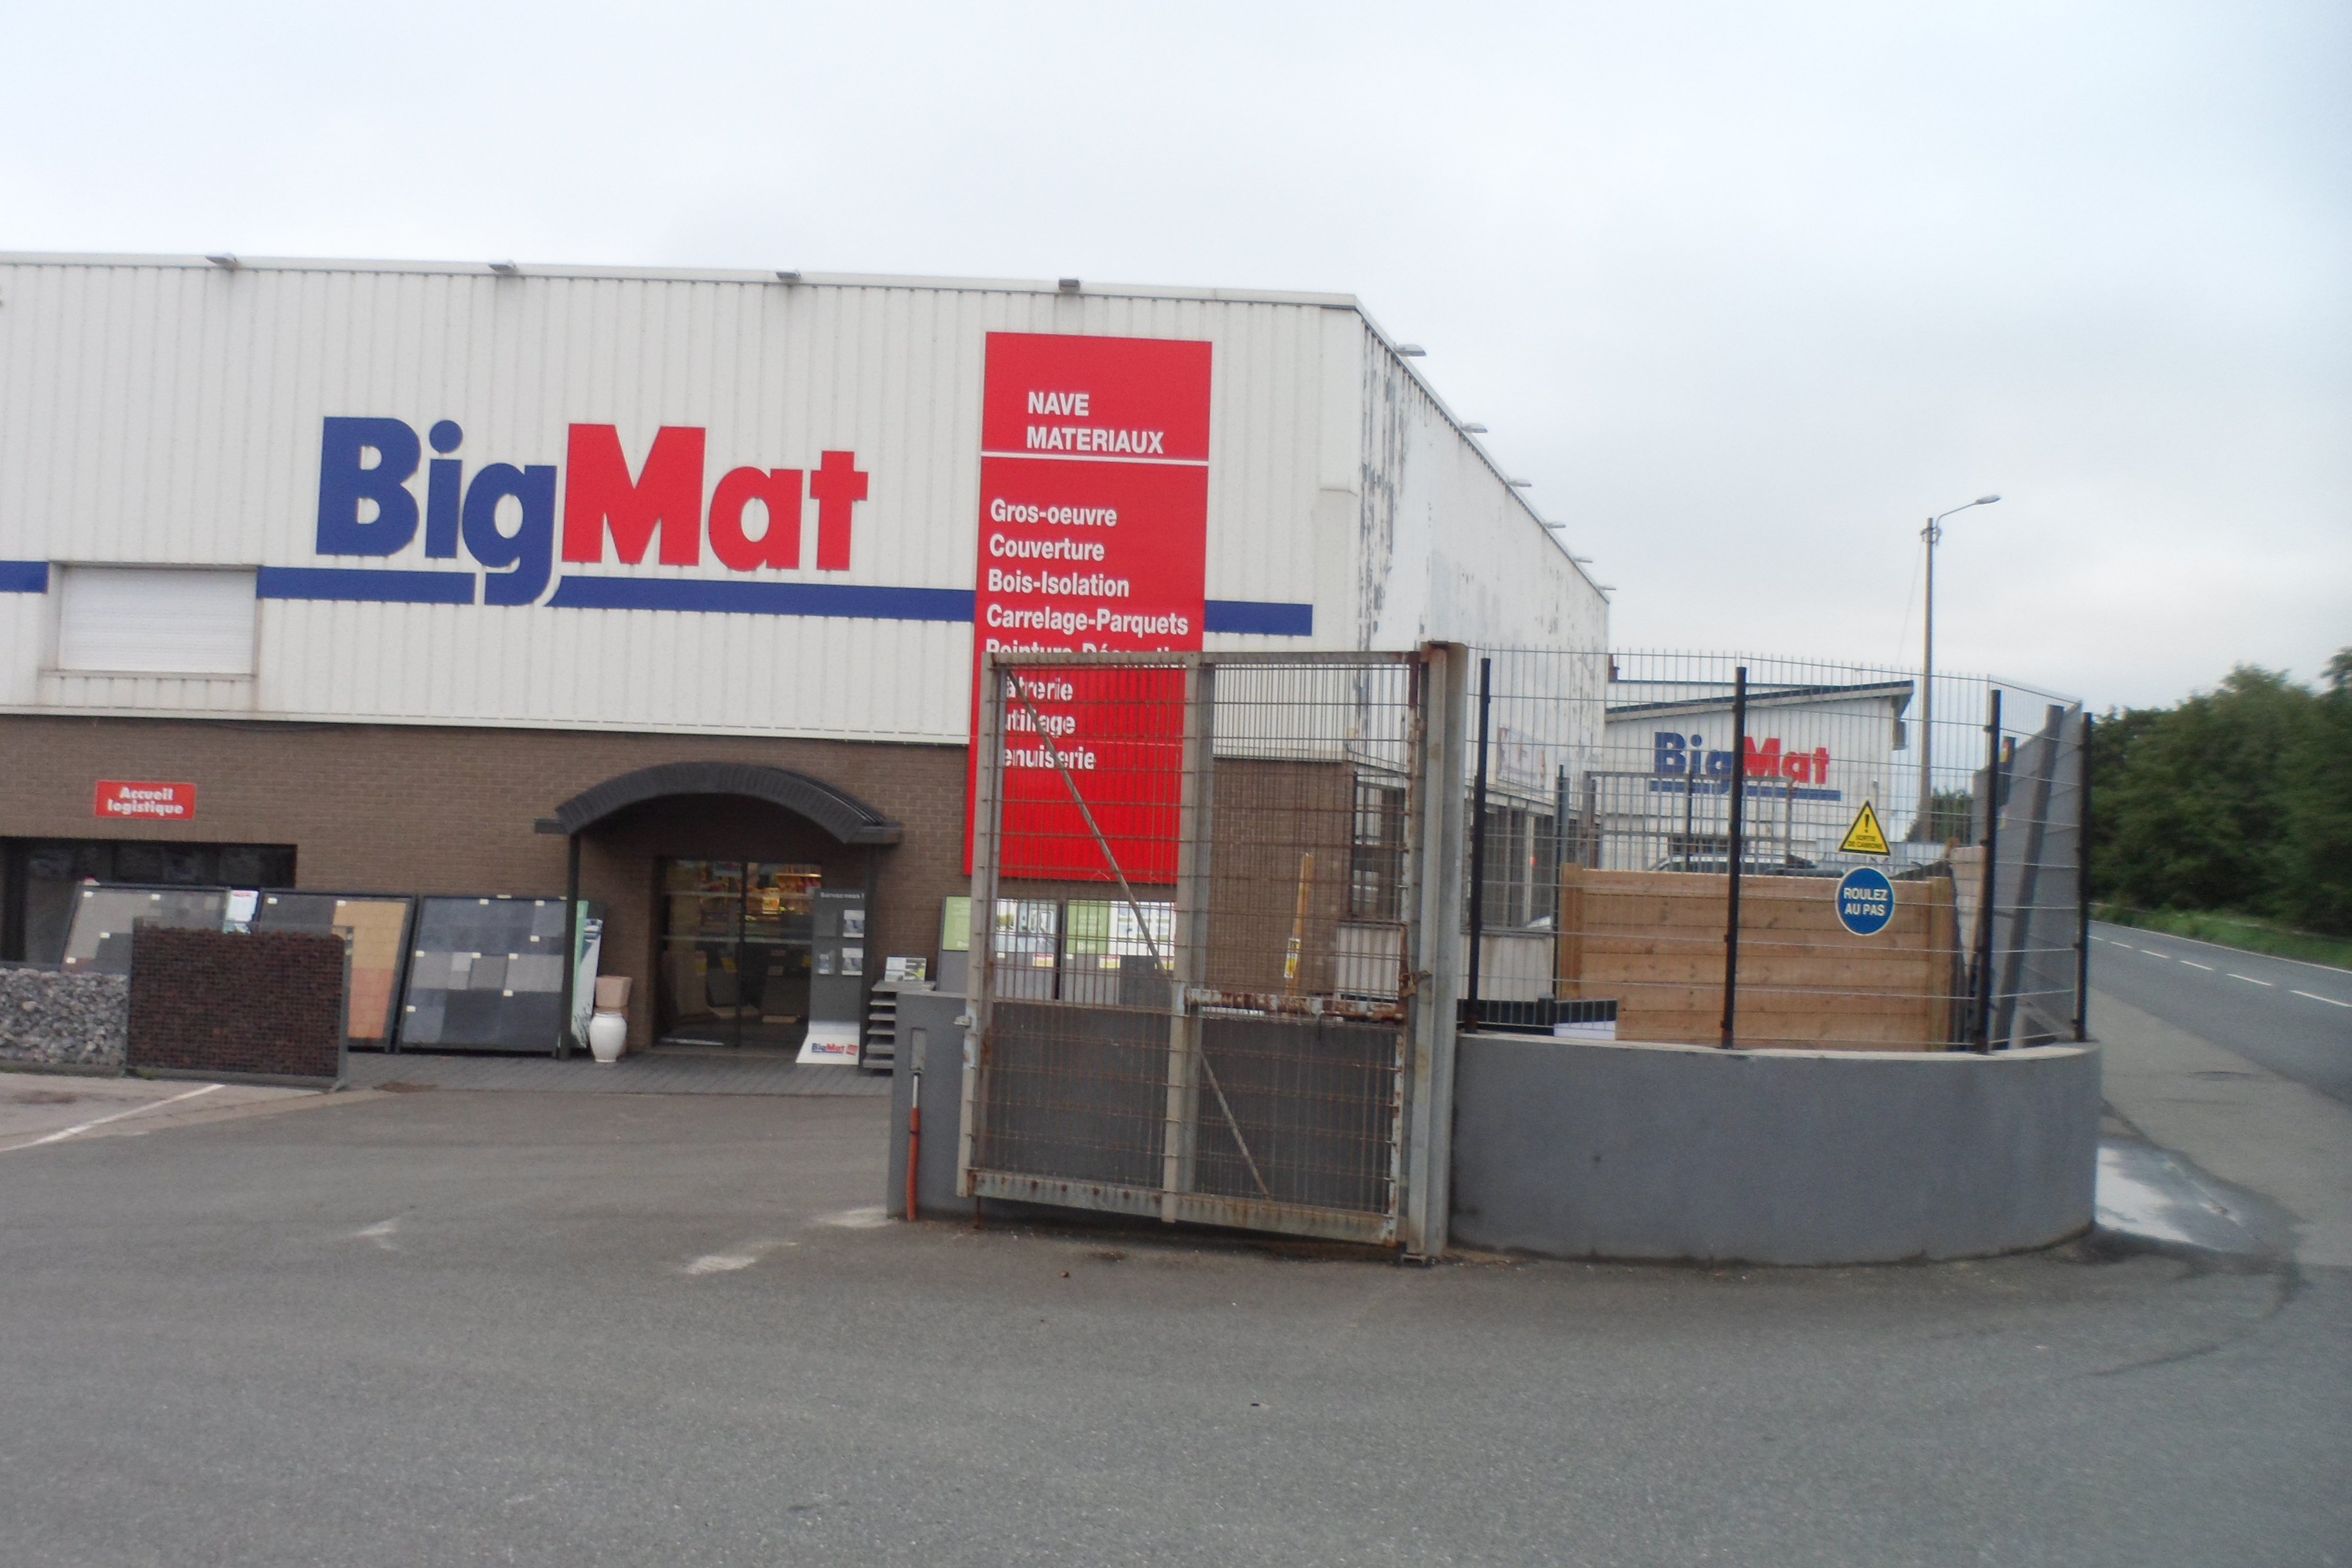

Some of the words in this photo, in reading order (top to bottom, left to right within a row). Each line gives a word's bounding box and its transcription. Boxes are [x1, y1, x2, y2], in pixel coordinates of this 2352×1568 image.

[1027, 391, 1090, 416] NAVE
[1026, 426, 1164, 454] MATERIAUX
[315, 415, 869, 607] BigMat
[990, 498, 1118, 527] Gros-oeuvre
[989, 533, 1105, 561] Couverture
[988, 569, 1130, 597] Bois-Isolation
[987, 604, 1189, 638] Carrelage-Parquets
[1003, 745, 1096, 770] enuiserie
[1654, 731, 1830, 795] BigMat
[107, 798, 184, 817] logistique
[119, 787, 174, 801] Accueil
[1843, 887, 1888, 901] ROULEZ
[1844, 902, 1861, 916] AU
[1862, 903, 1886, 917] PAS
